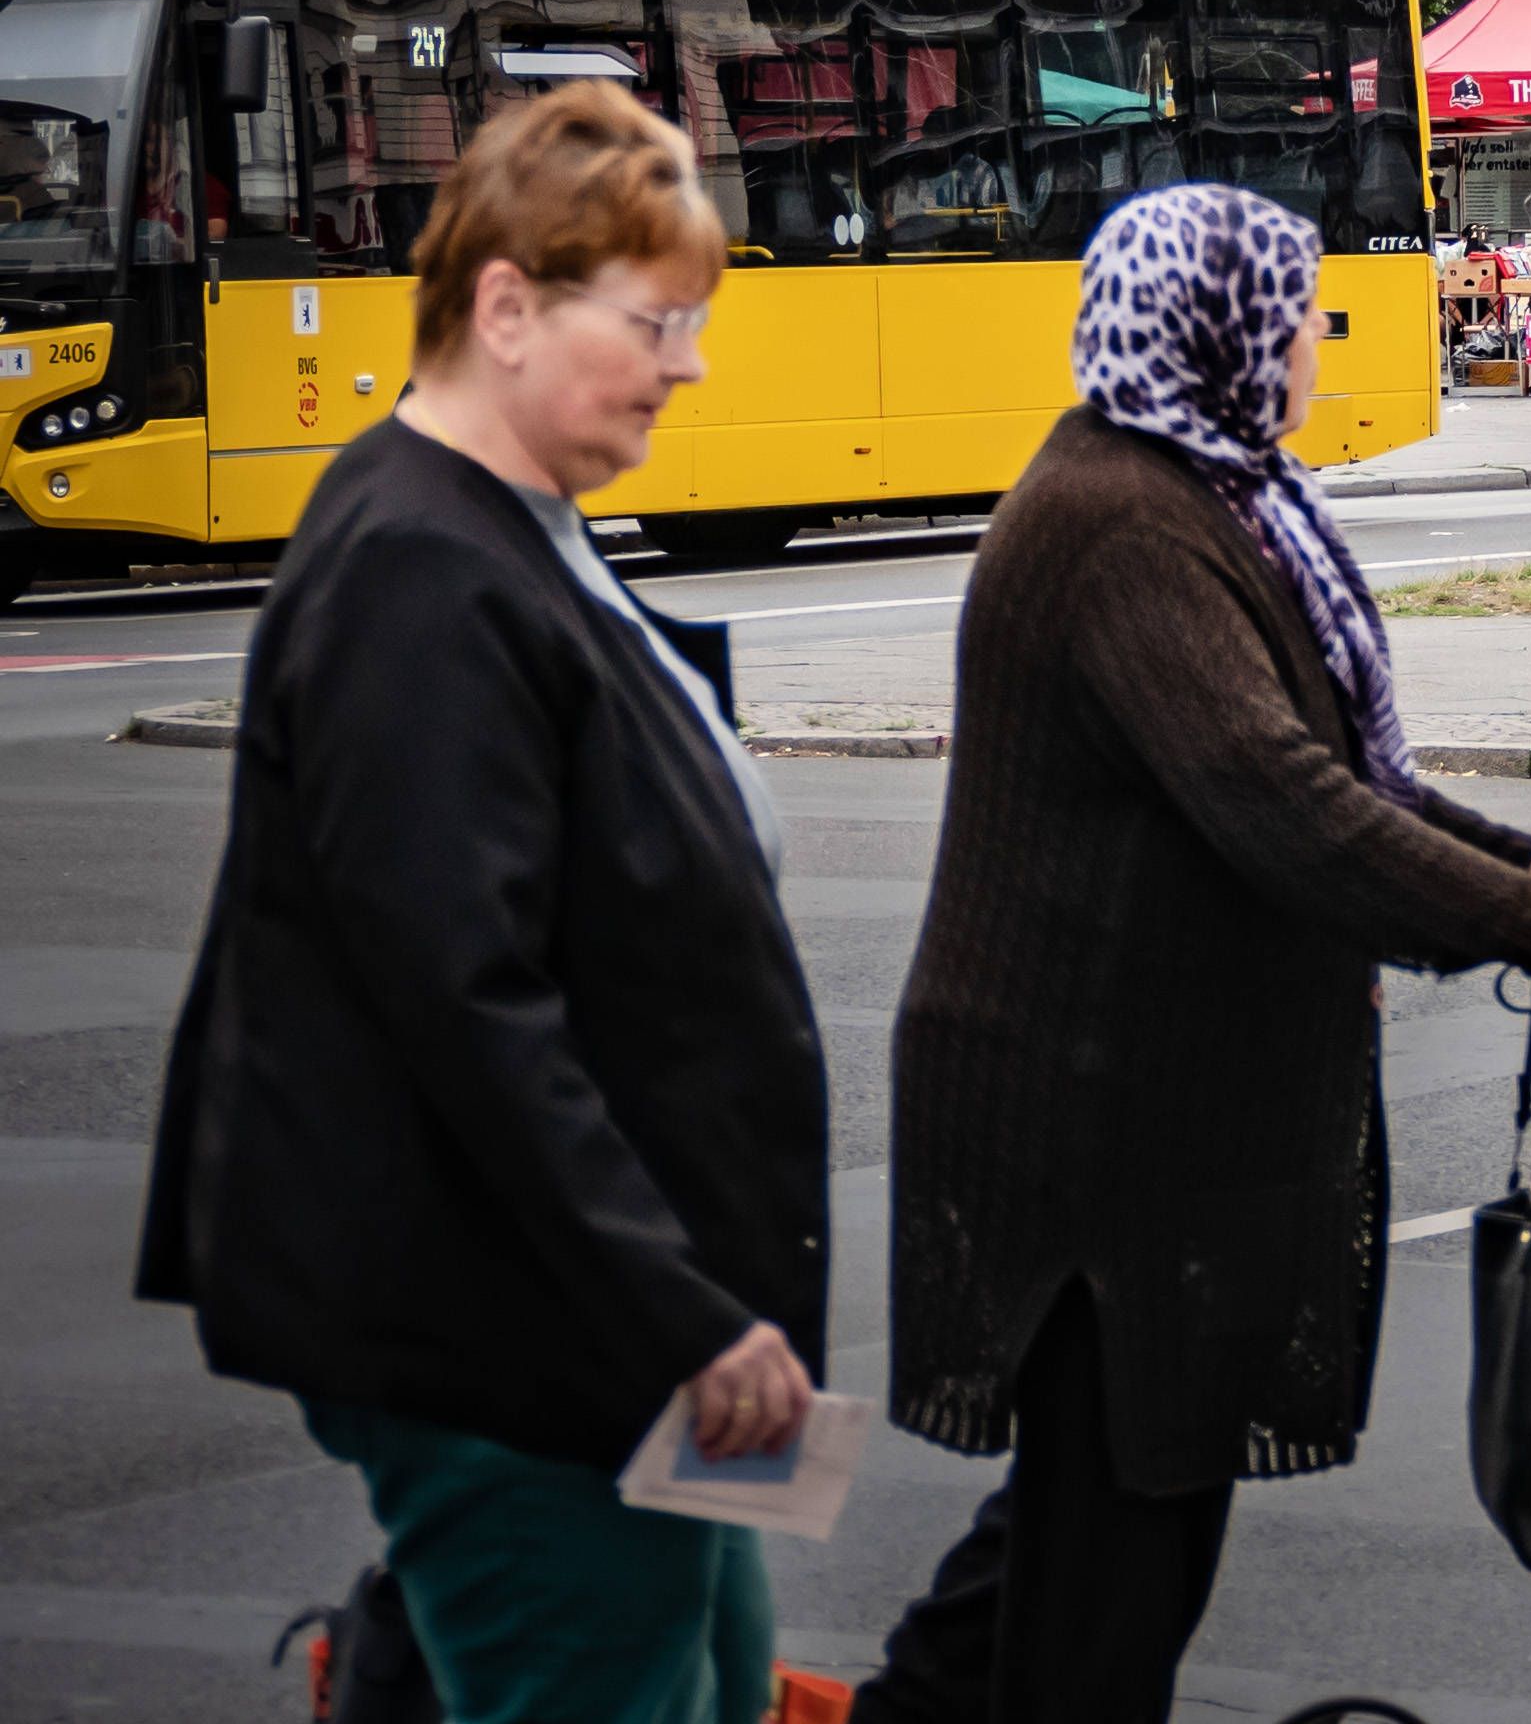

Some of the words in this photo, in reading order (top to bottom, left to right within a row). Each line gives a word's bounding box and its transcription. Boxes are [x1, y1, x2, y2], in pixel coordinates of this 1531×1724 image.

[411, 26, 446, 67] 247
[1490, 139, 1514, 154] soll
[1368, 236, 1423, 251] CITEA
[49, 342, 96, 364] 2406
[298, 357, 318, 375] BVG
[300, 398, 317, 412] VBB
